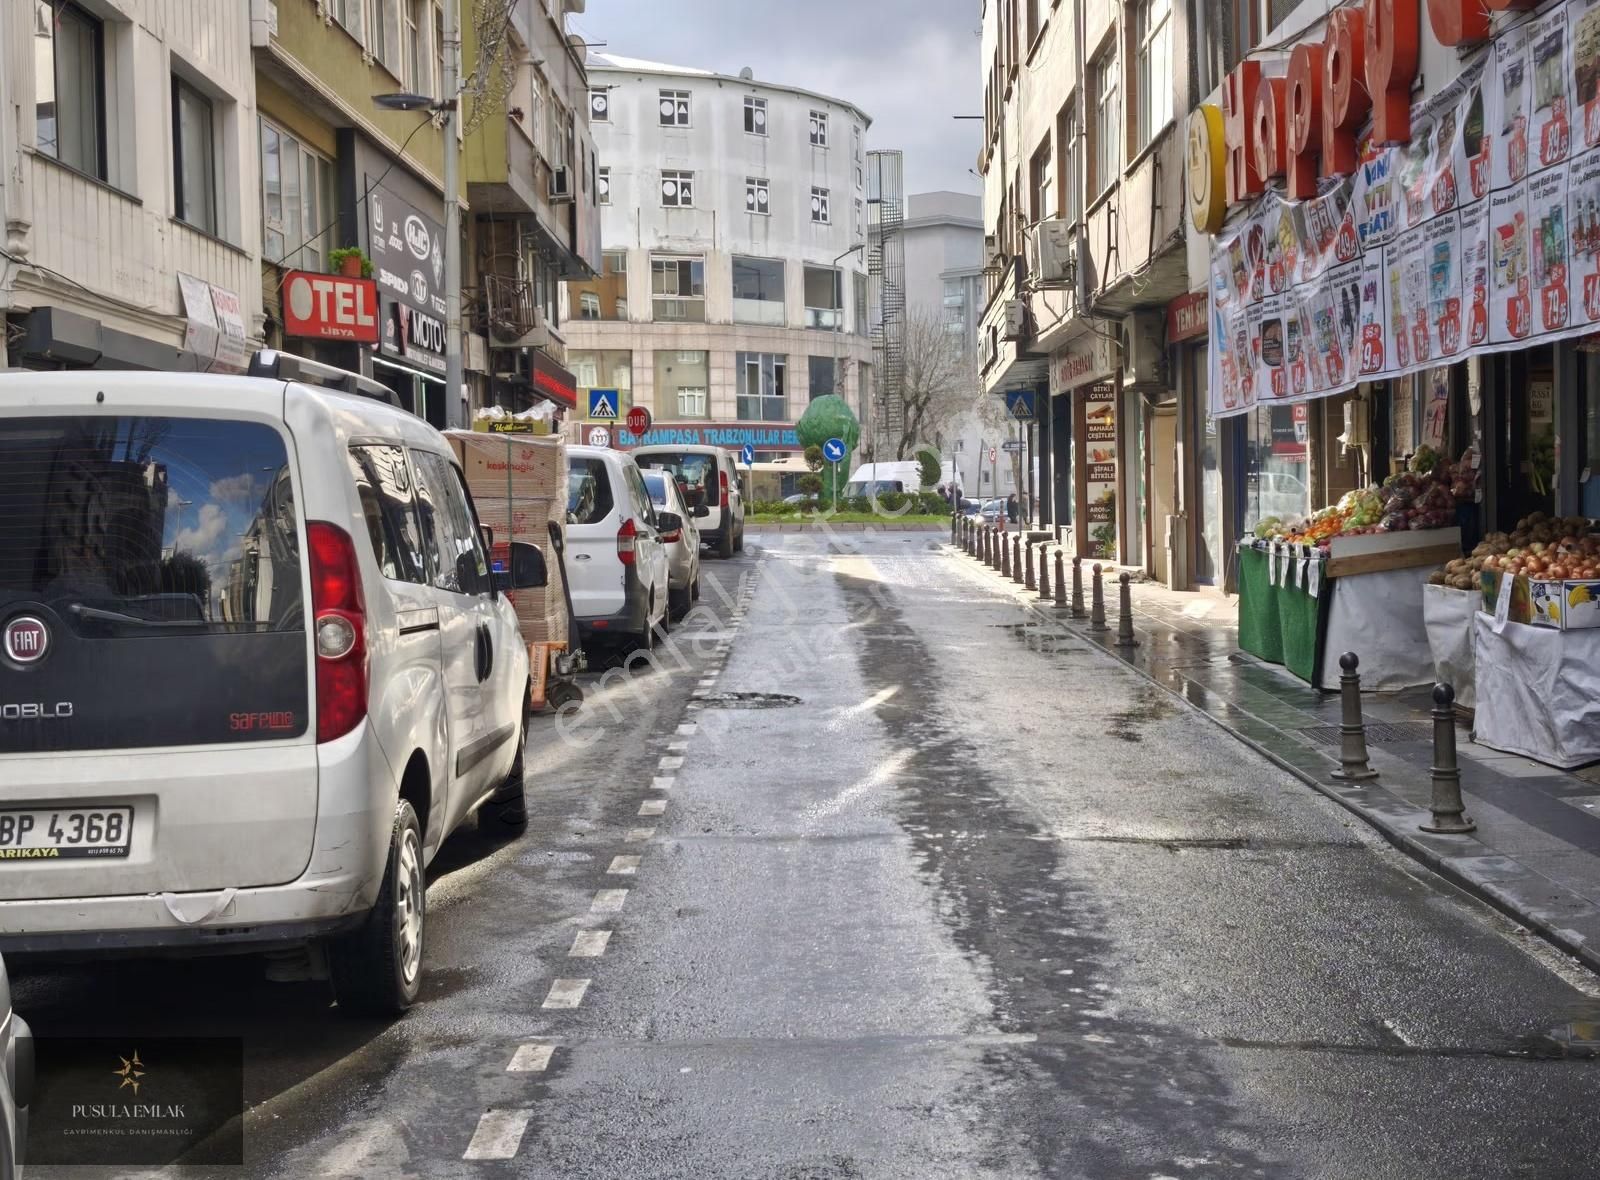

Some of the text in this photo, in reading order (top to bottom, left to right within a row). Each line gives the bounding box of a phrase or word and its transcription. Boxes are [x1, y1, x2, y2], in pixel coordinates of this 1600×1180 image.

[408, 223, 427, 252] HJC
[289, 277, 374, 326] OTEL
[321, 326, 355, 336] LİBYA
[413, 310, 442, 352] MOTO
[628, 415, 647, 428] DUR
[14, 630, 39, 651] FIAT
[0, 812, 123, 846] BP 4368
